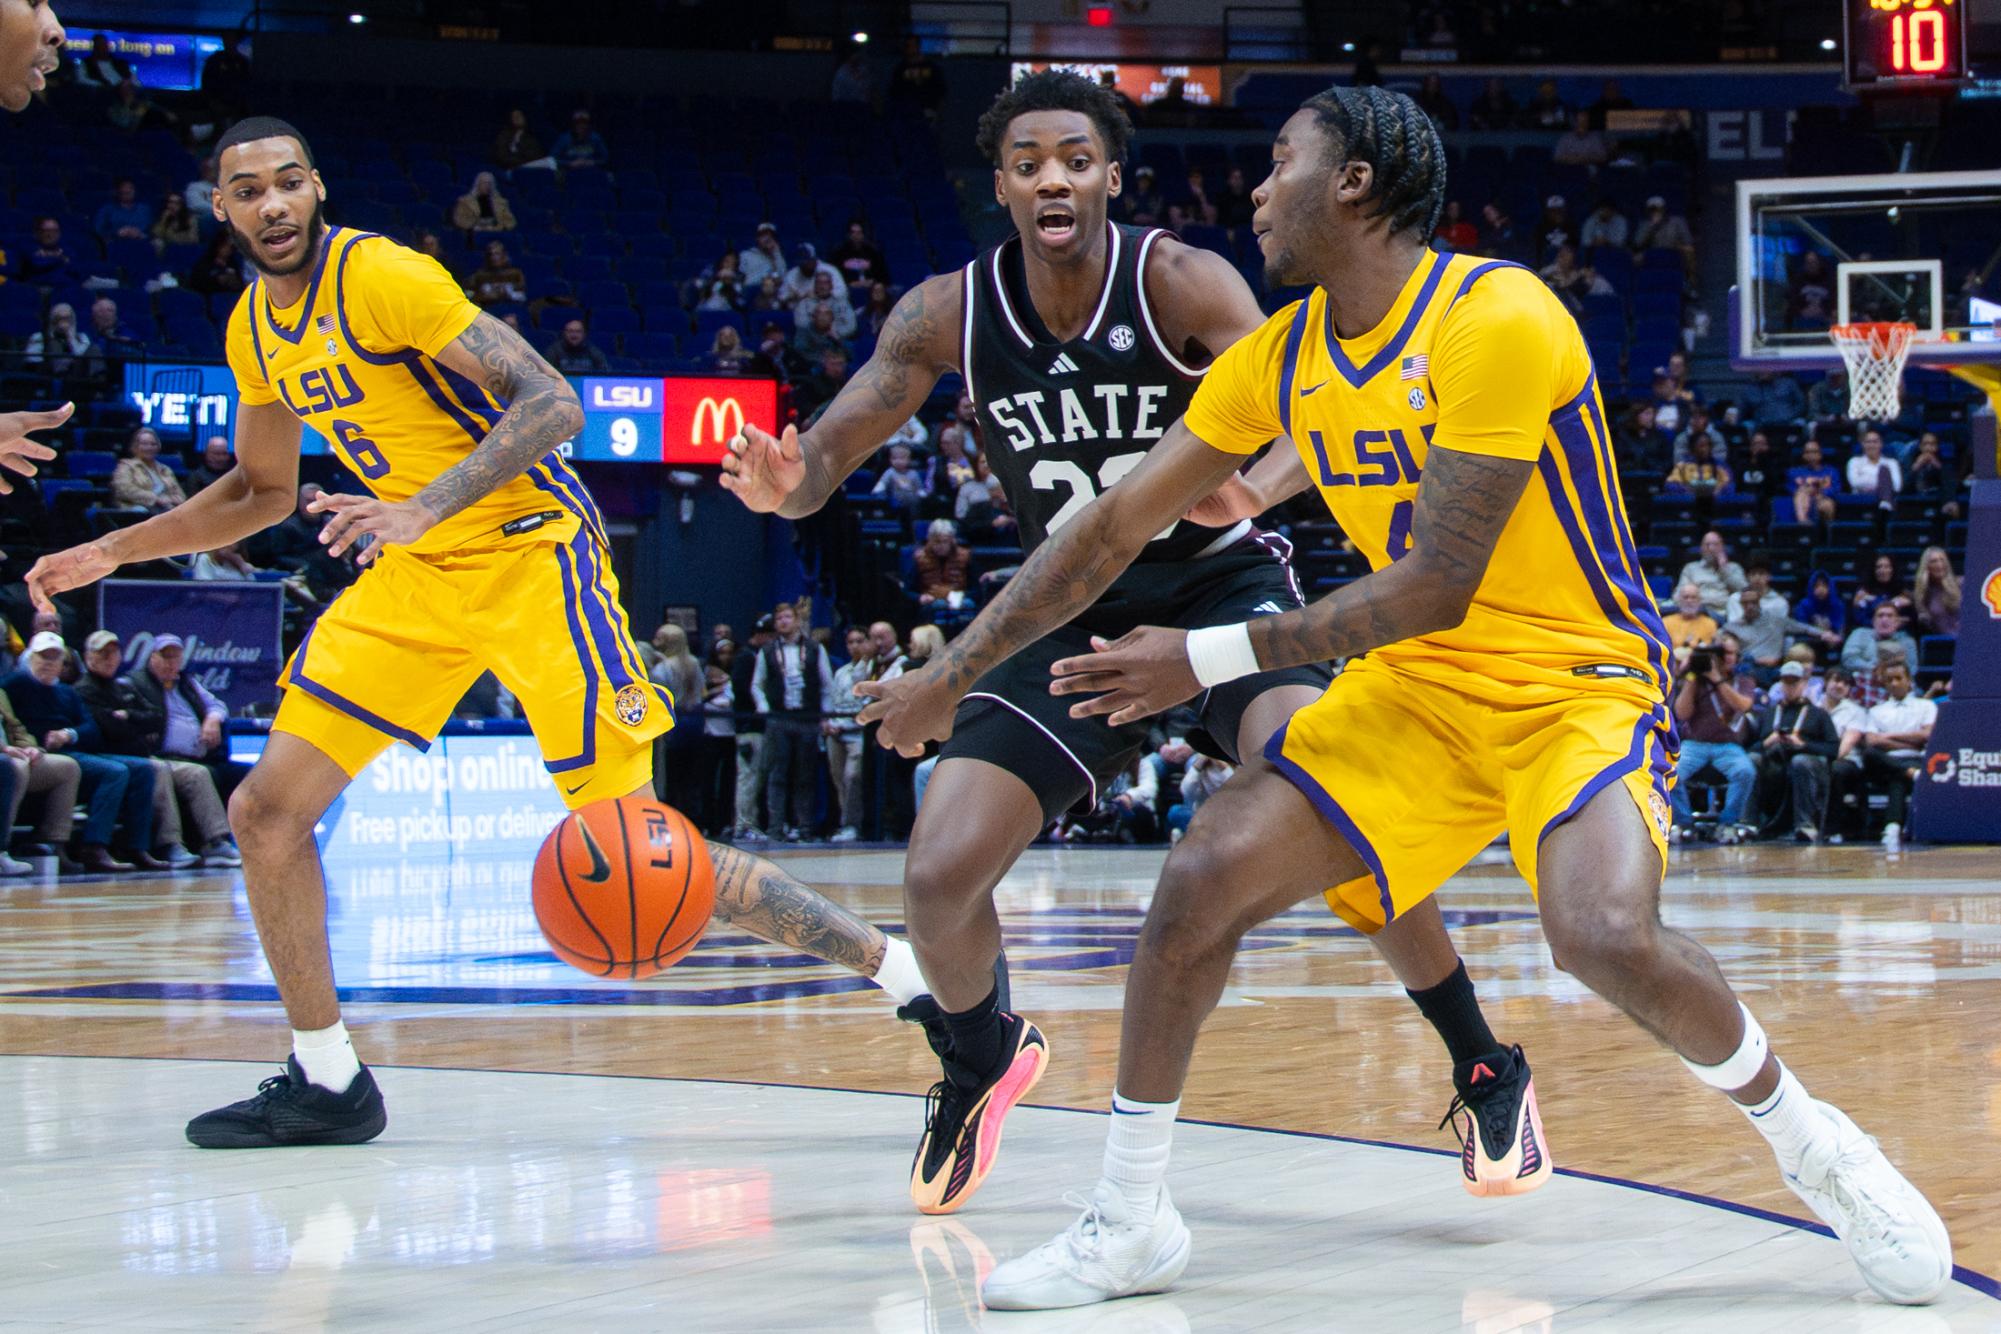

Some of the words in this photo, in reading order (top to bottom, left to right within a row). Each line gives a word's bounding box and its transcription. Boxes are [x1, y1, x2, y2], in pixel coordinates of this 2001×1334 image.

[1892, 10, 1945, 71] 10
[1708, 110, 1797, 160] EL
[1110, 328, 1134, 348] SEC
[131, 391, 228, 426] YETI
[277, 363, 365, 417] LSU
[594, 385, 653, 408] LSU
[610, 417, 639, 457] 9
[987, 384, 1168, 452] STATE
[332, 419, 391, 480] 6
[1308, 423, 1437, 487] LSU
[372, 738, 454, 807] Shop
[1958, 748, 2001, 770] Equ
[1958, 768, 2001, 787] Sha
[351, 811, 398, 844] Free
[400, 807, 471, 852] pickup
[473, 819, 497, 840] or
[641, 807, 673, 869] LSU
